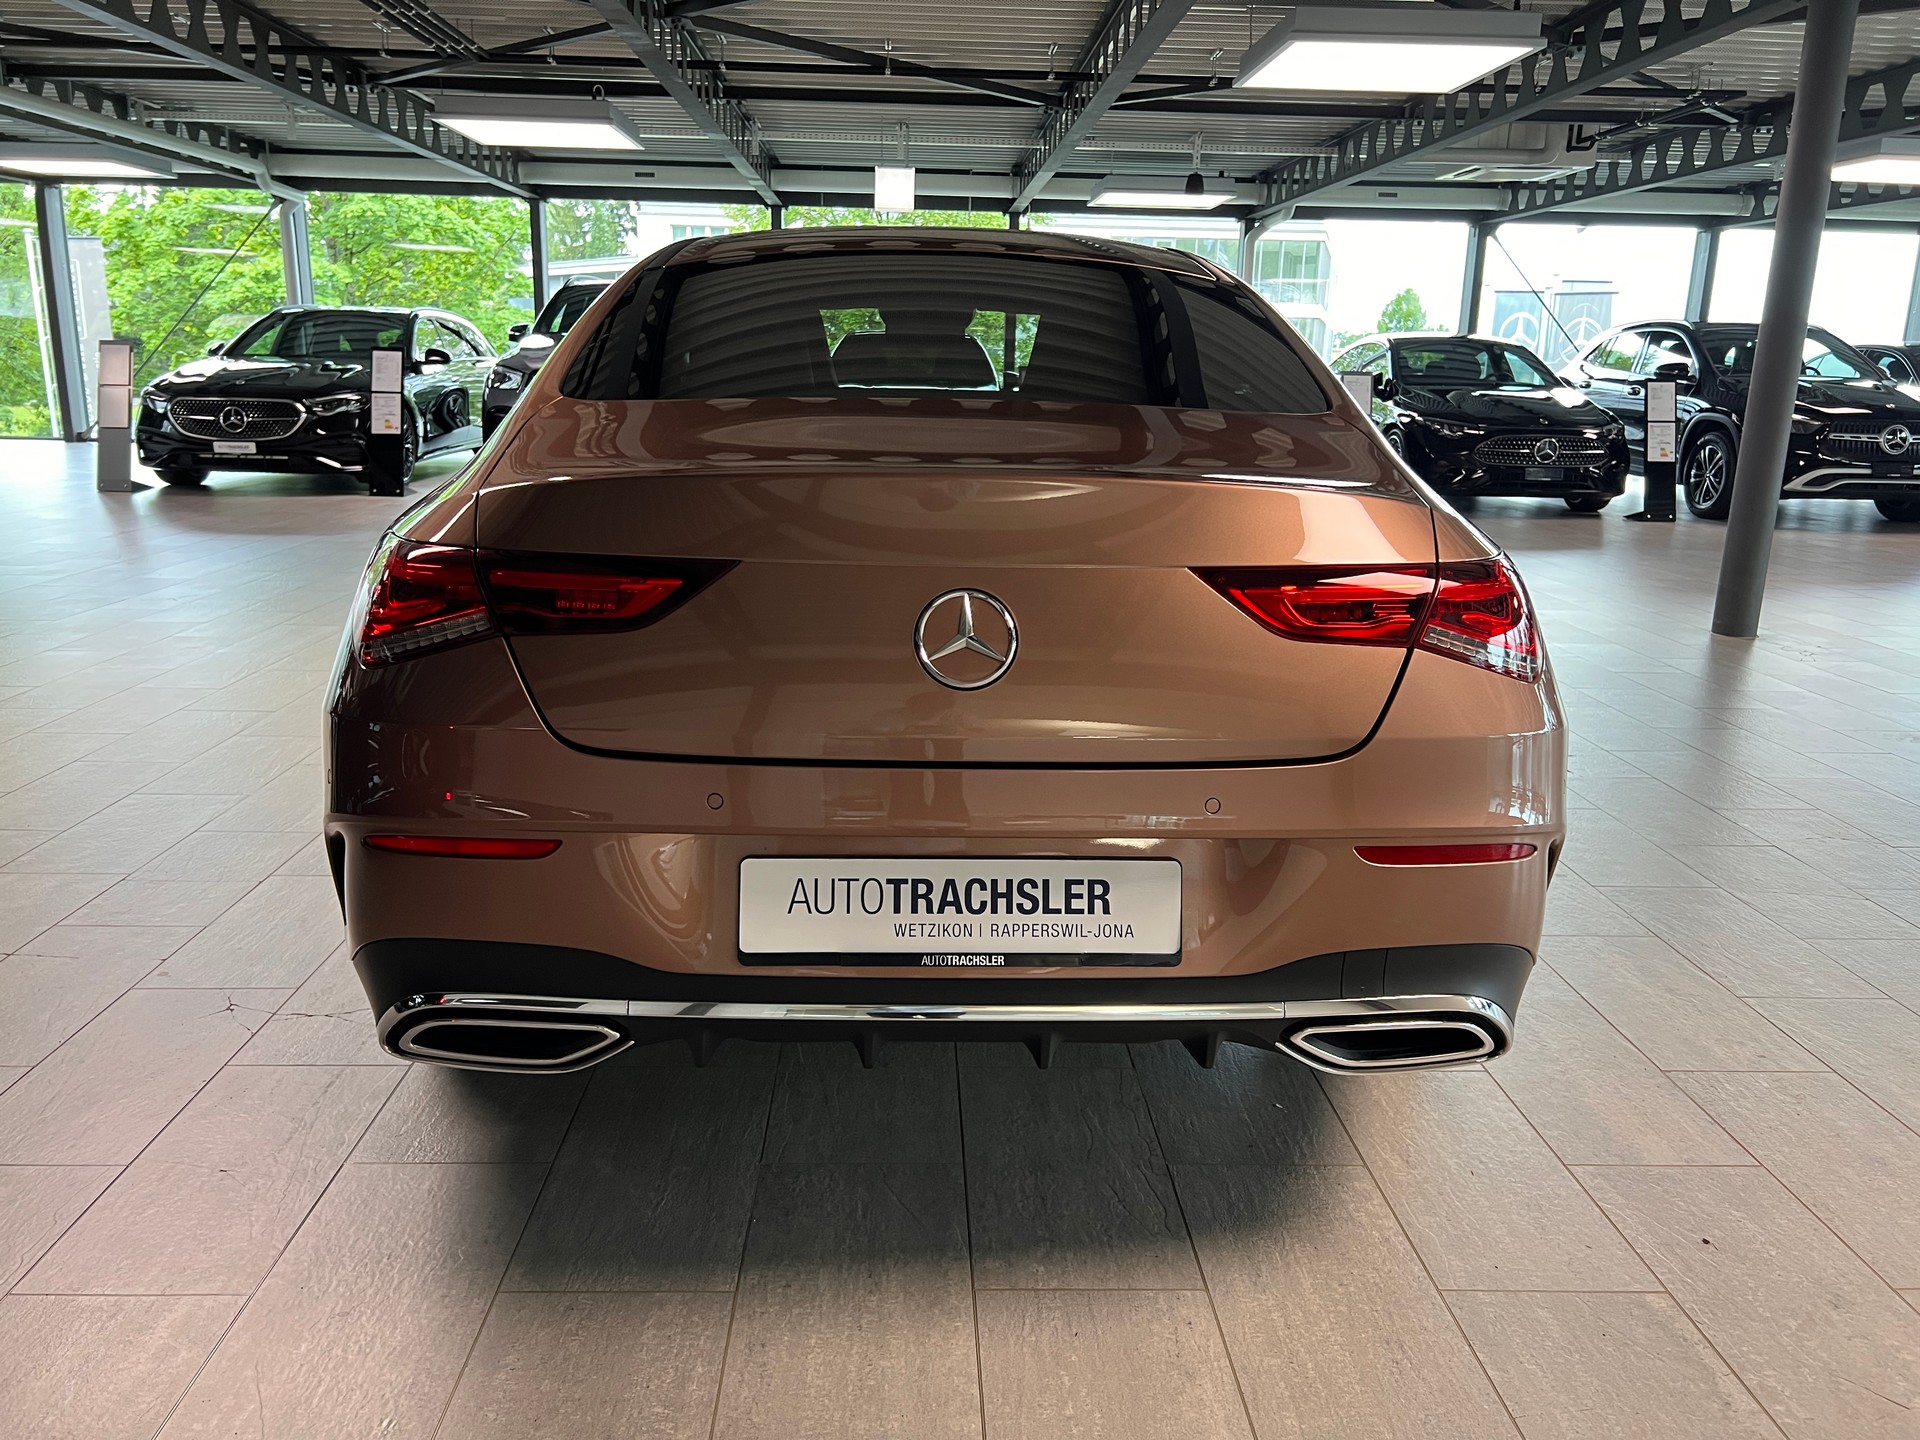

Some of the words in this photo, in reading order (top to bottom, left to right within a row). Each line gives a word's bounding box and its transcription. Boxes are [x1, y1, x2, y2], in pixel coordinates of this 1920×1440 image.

[787, 877, 1112, 916] AUTOTRACHSLER
[893, 923, 973, 939] WETZIKON
[990, 923, 1135, 939] RAPPERSWIL-JONA
[921, 955, 1005, 966] AUTOTRACHSLER
